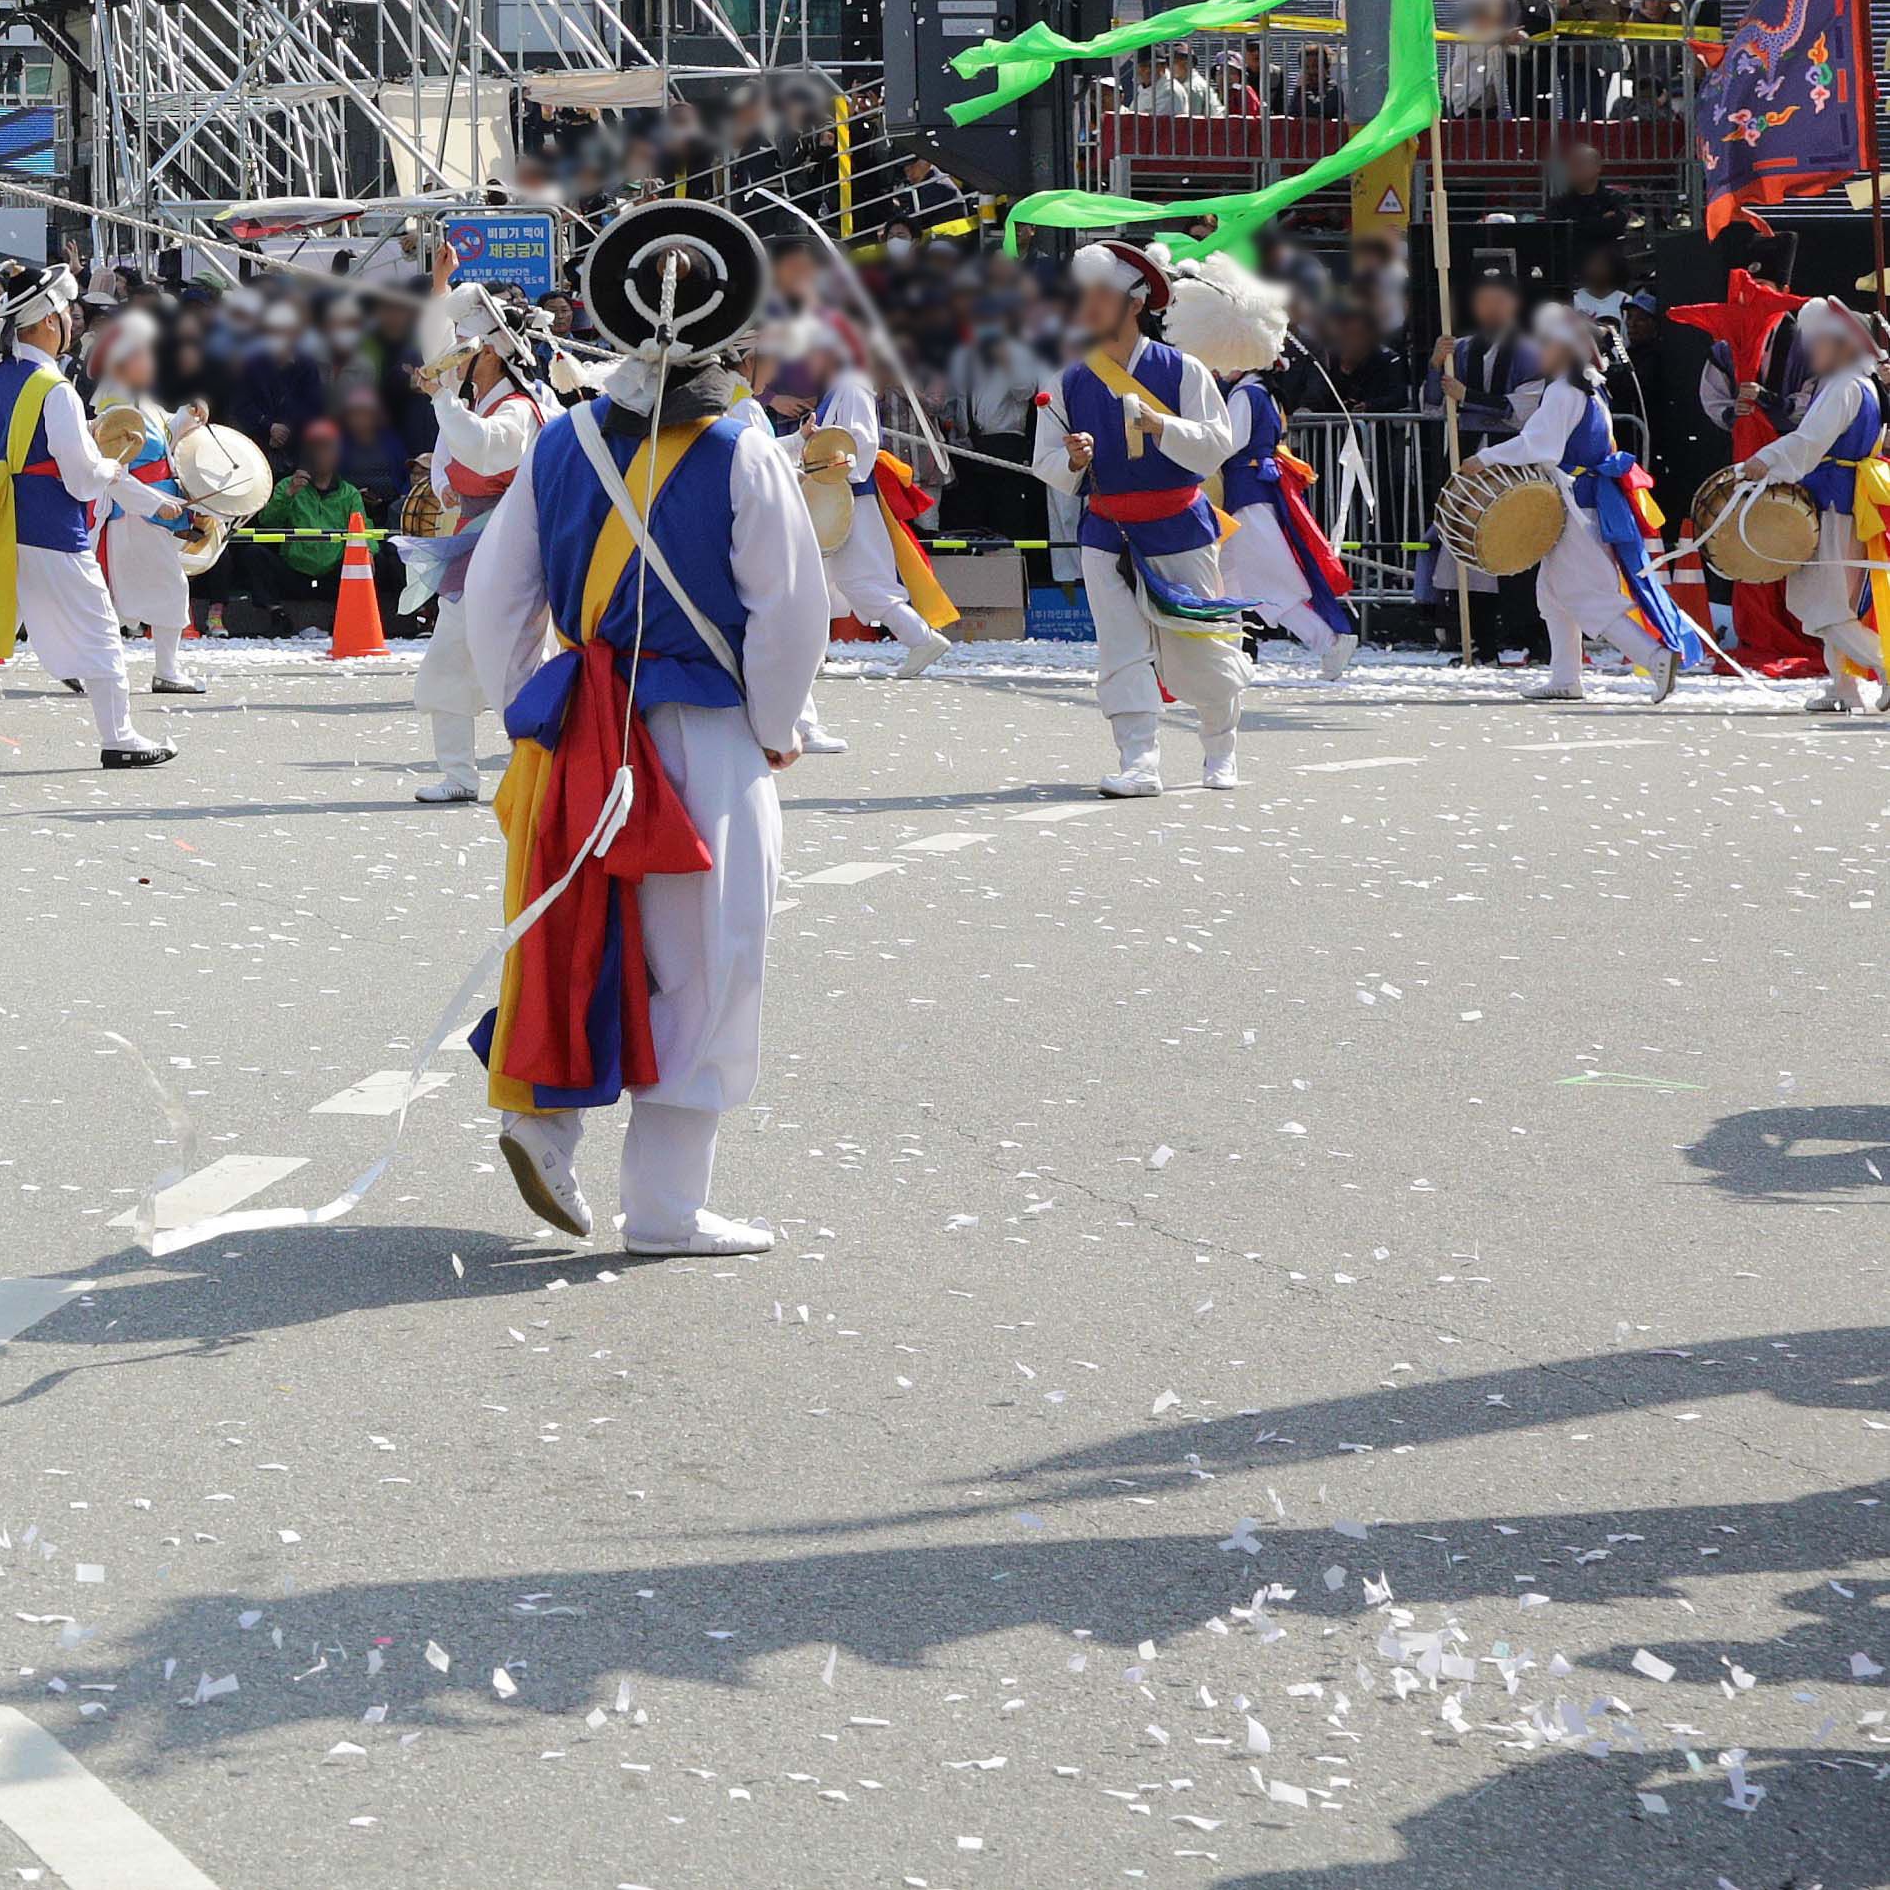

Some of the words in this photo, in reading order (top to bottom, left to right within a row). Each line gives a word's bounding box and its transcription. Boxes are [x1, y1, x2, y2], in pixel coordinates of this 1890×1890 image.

[487, 227, 520, 239] 비둘기
[523, 226, 545, 239] 먹이
[488, 243, 545, 259] 제공금지
